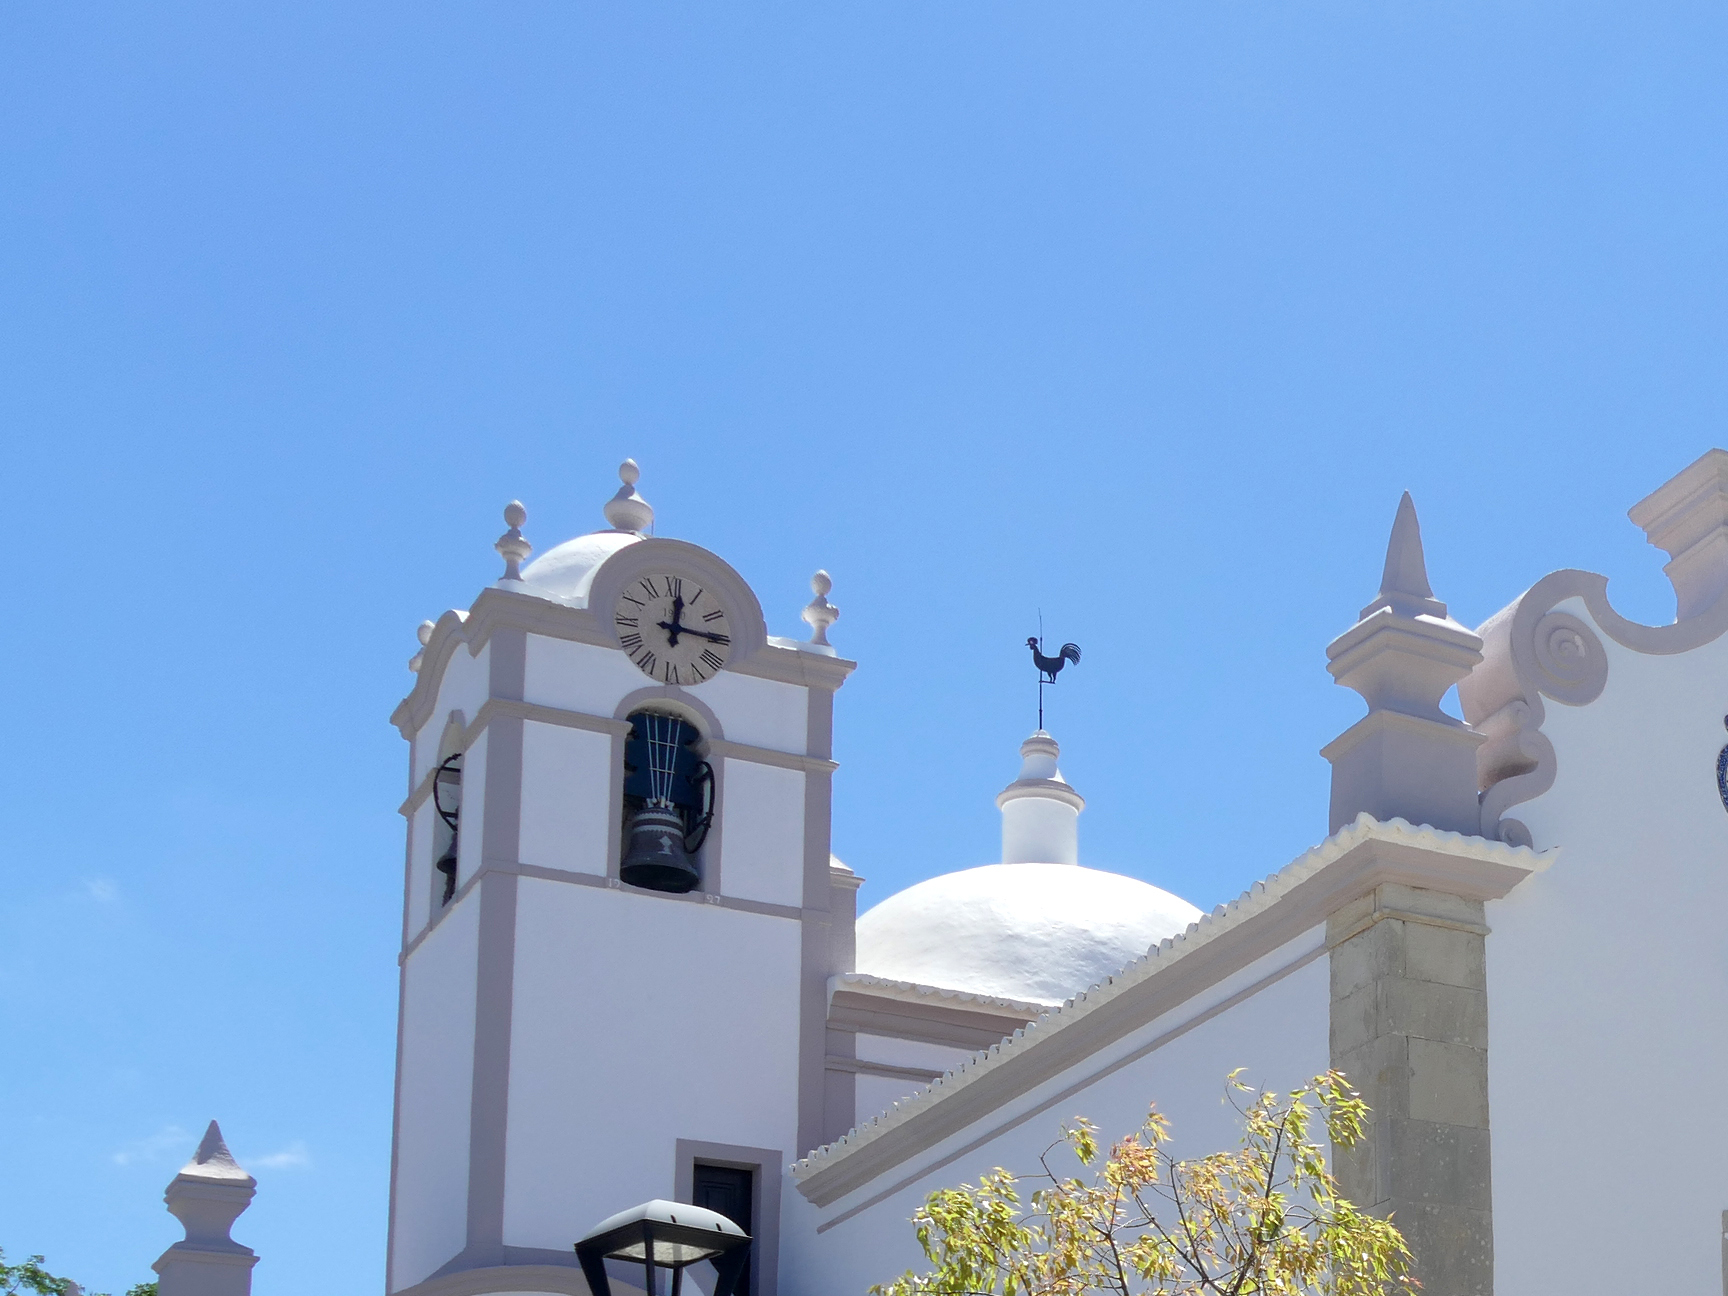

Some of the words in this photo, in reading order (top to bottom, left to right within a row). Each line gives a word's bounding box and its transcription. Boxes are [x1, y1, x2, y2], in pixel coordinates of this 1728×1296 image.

[639, 577, 660, 601] XI
[665, 576, 682, 598] XII
[689, 587, 704, 605] I
[622, 590, 646, 612] X
[615, 612, 639, 628] IX
[664, 607, 686, 620] 190
[702, 609, 724, 623] II
[619, 632, 645, 657] VIII
[708, 631, 731, 646] II
[636, 650, 657, 676] VII
[699, 648, 724, 672] IIII
[665, 661, 681, 685] VI
[690, 662, 706, 684] V
